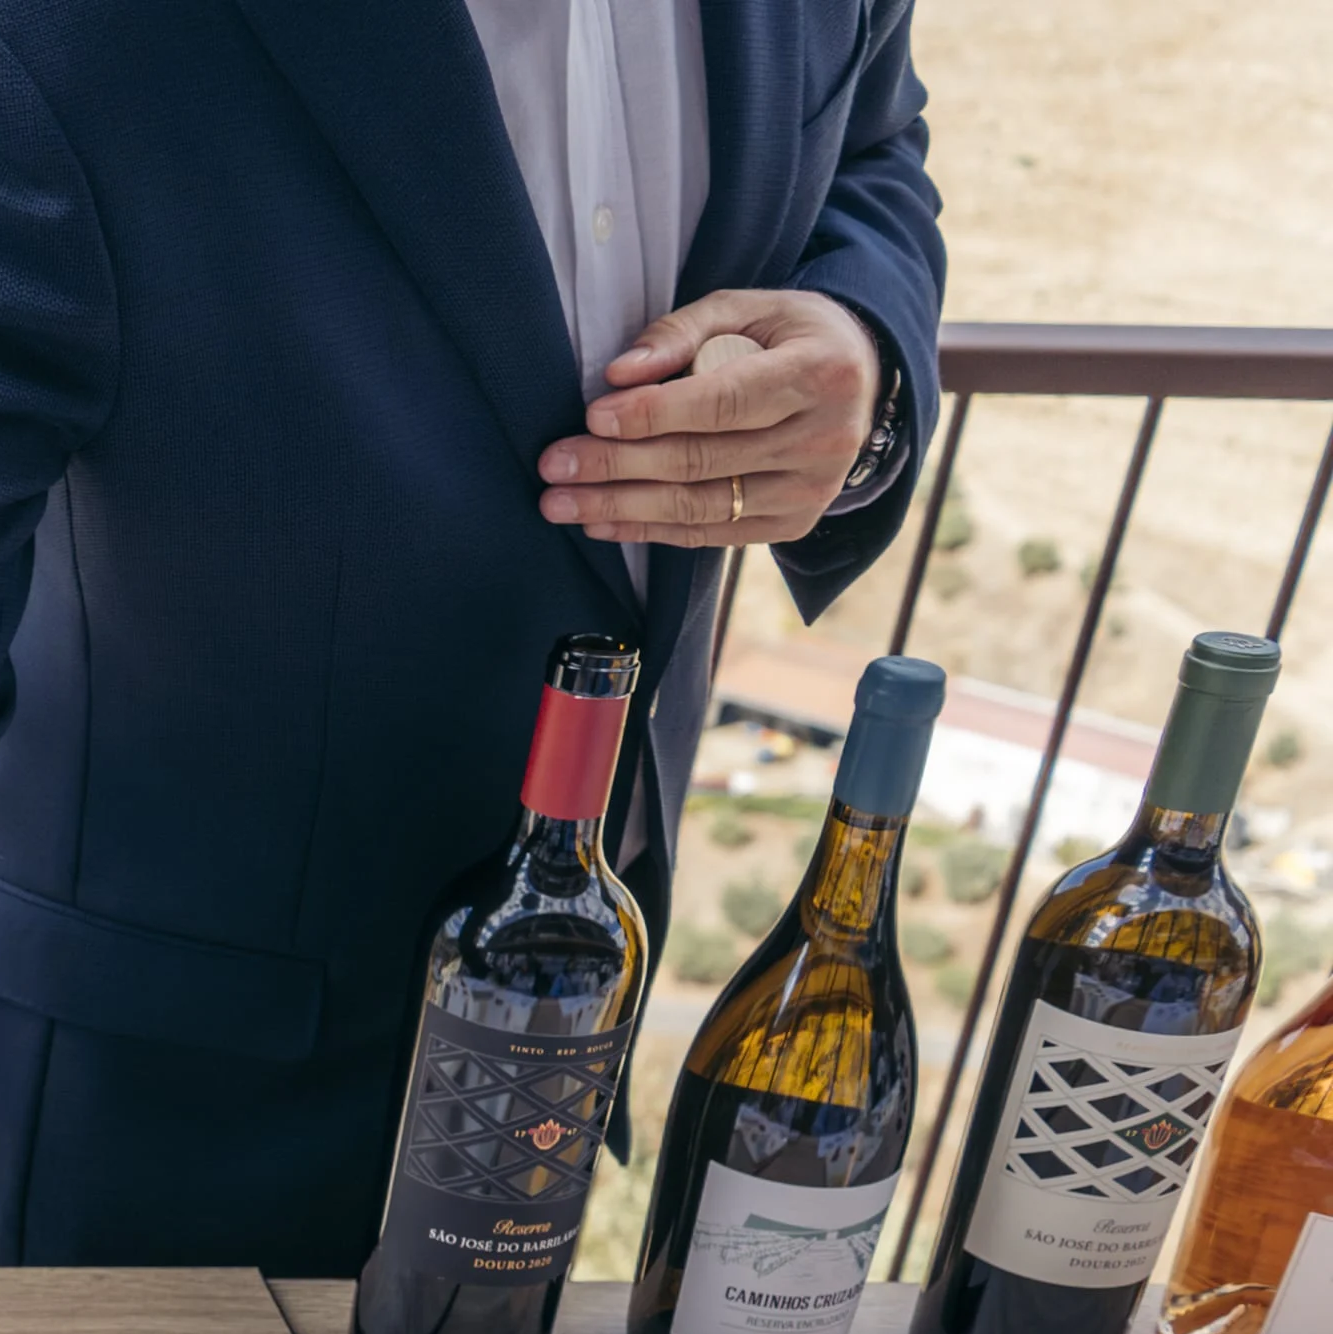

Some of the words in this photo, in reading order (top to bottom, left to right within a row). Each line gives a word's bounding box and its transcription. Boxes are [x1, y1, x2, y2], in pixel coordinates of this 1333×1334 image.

[509, 1044, 544, 1055] TINTO
[556, 1048, 577, 1056] RED
[493, 1218, 552, 1235] Reserva
[428, 1227, 457, 1245] SÃO
[460, 1236, 493, 1253] JOSÉ
[497, 1241, 519, 1253] DO
[1024, 1228, 1055, 1245] SÃO
[1058, 1237, 1094, 1252] JOSÉ
[1097, 1243, 1119, 1253] DO
[473, 1258, 526, 1271] DOURO
[1069, 1257, 1121, 1270] DOURO
[724, 1285, 811, 1310] CAMINHOS
